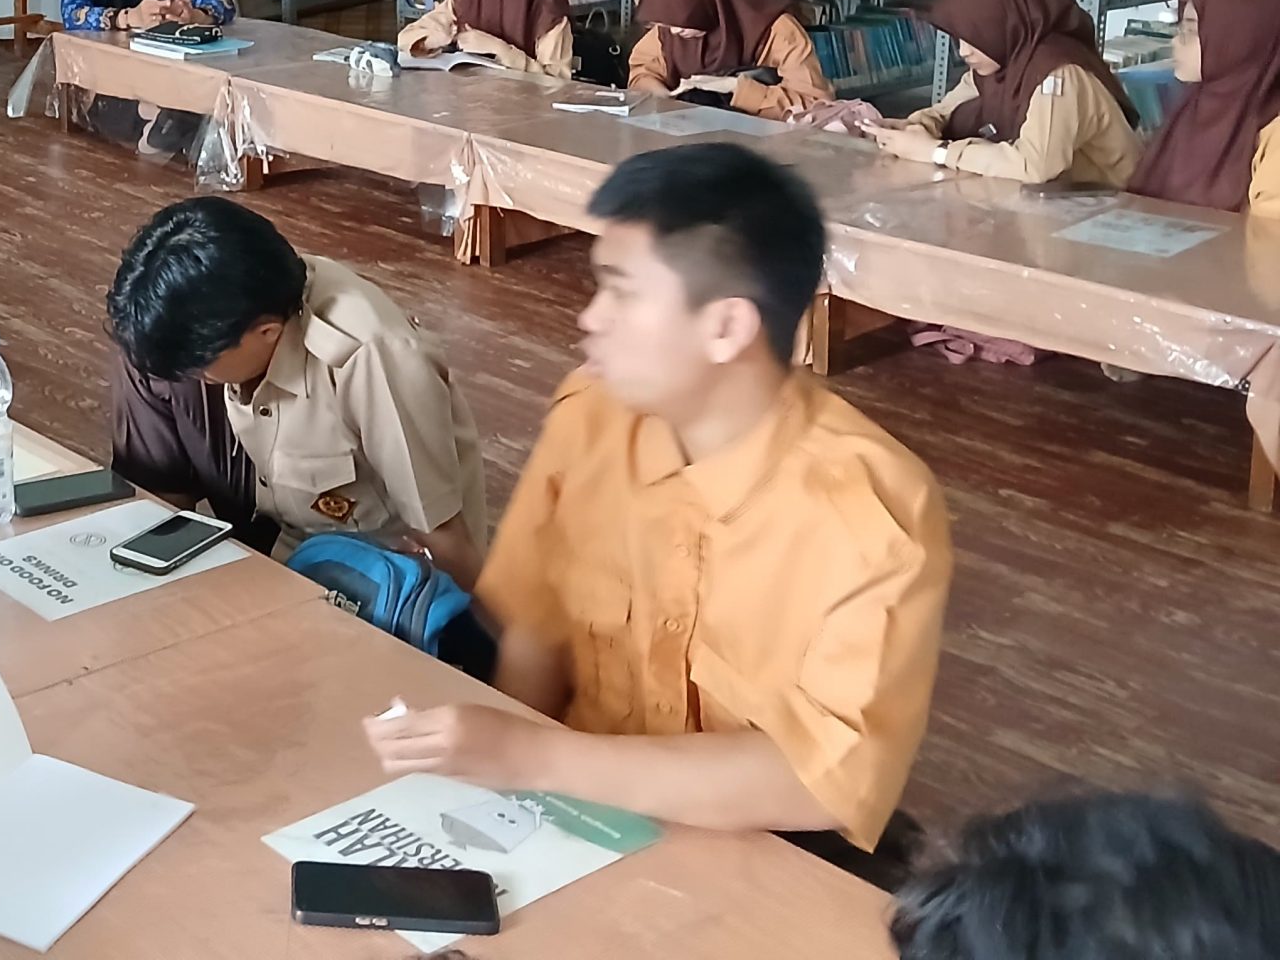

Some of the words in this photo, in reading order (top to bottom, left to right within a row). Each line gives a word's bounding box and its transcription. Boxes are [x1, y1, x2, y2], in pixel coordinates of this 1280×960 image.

[9, 565, 52, 590] FOOD
[22, 555, 78, 588] DRINKS
[47, 589, 74, 604] NO
